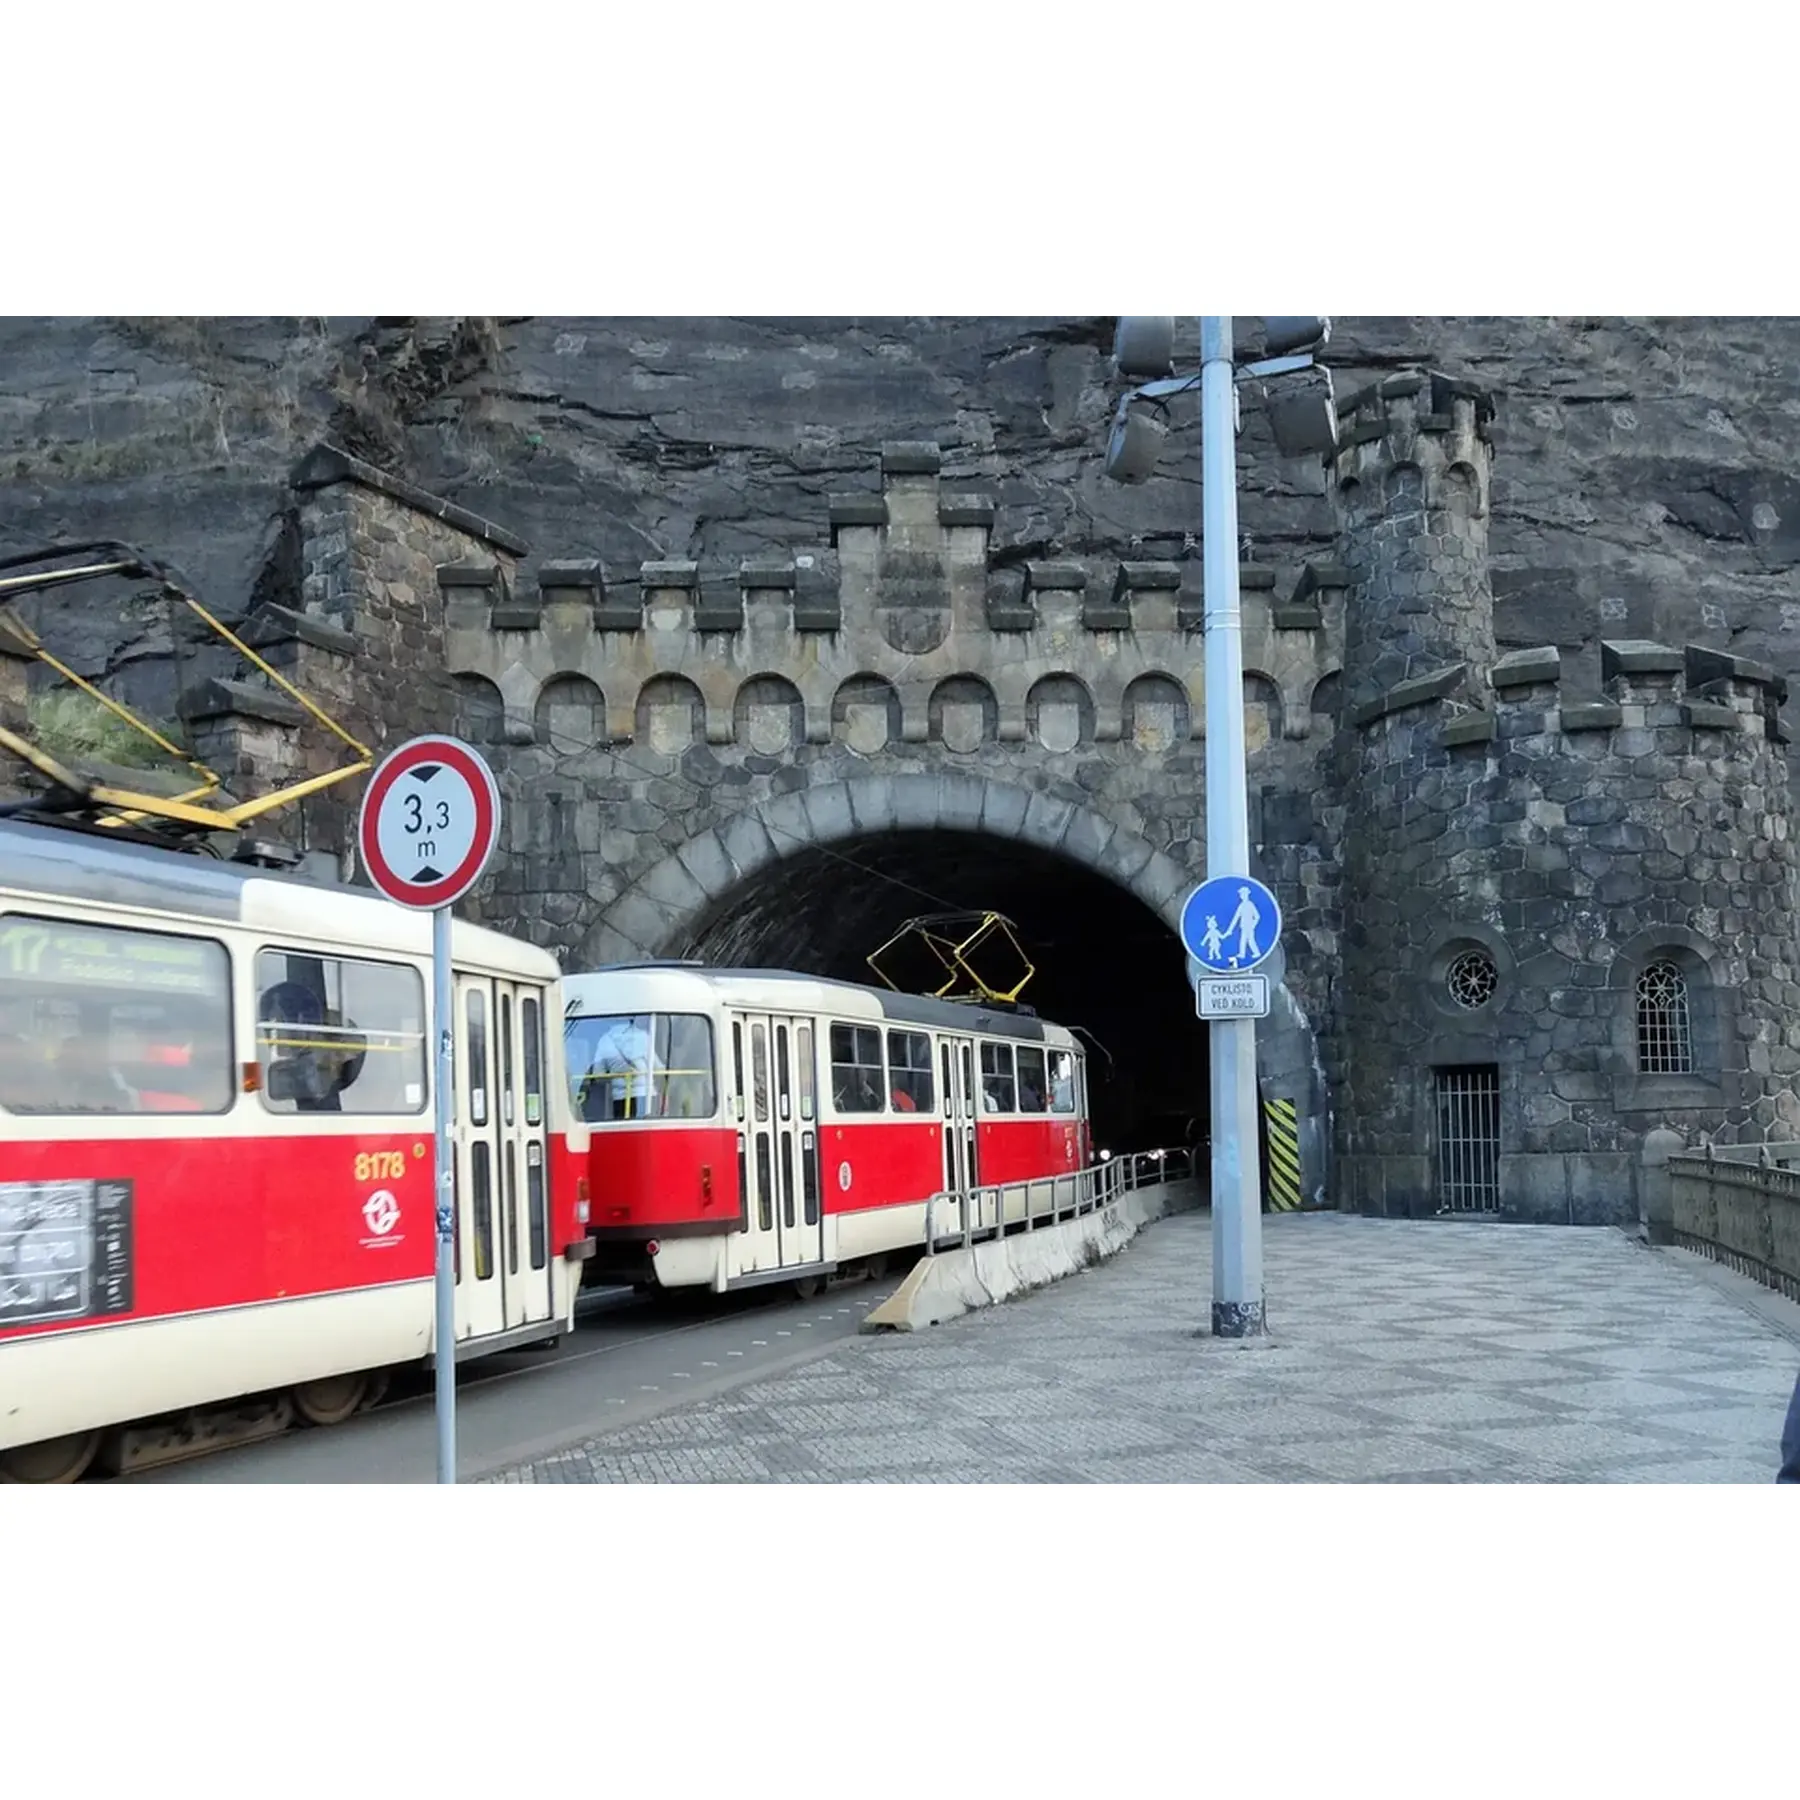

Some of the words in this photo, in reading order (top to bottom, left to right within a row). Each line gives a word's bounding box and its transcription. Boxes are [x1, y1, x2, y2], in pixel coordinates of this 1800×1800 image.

[403, 794, 450, 834] 3,3
[417, 840, 436, 857] m
[354, 1151, 406, 1181] 8178
